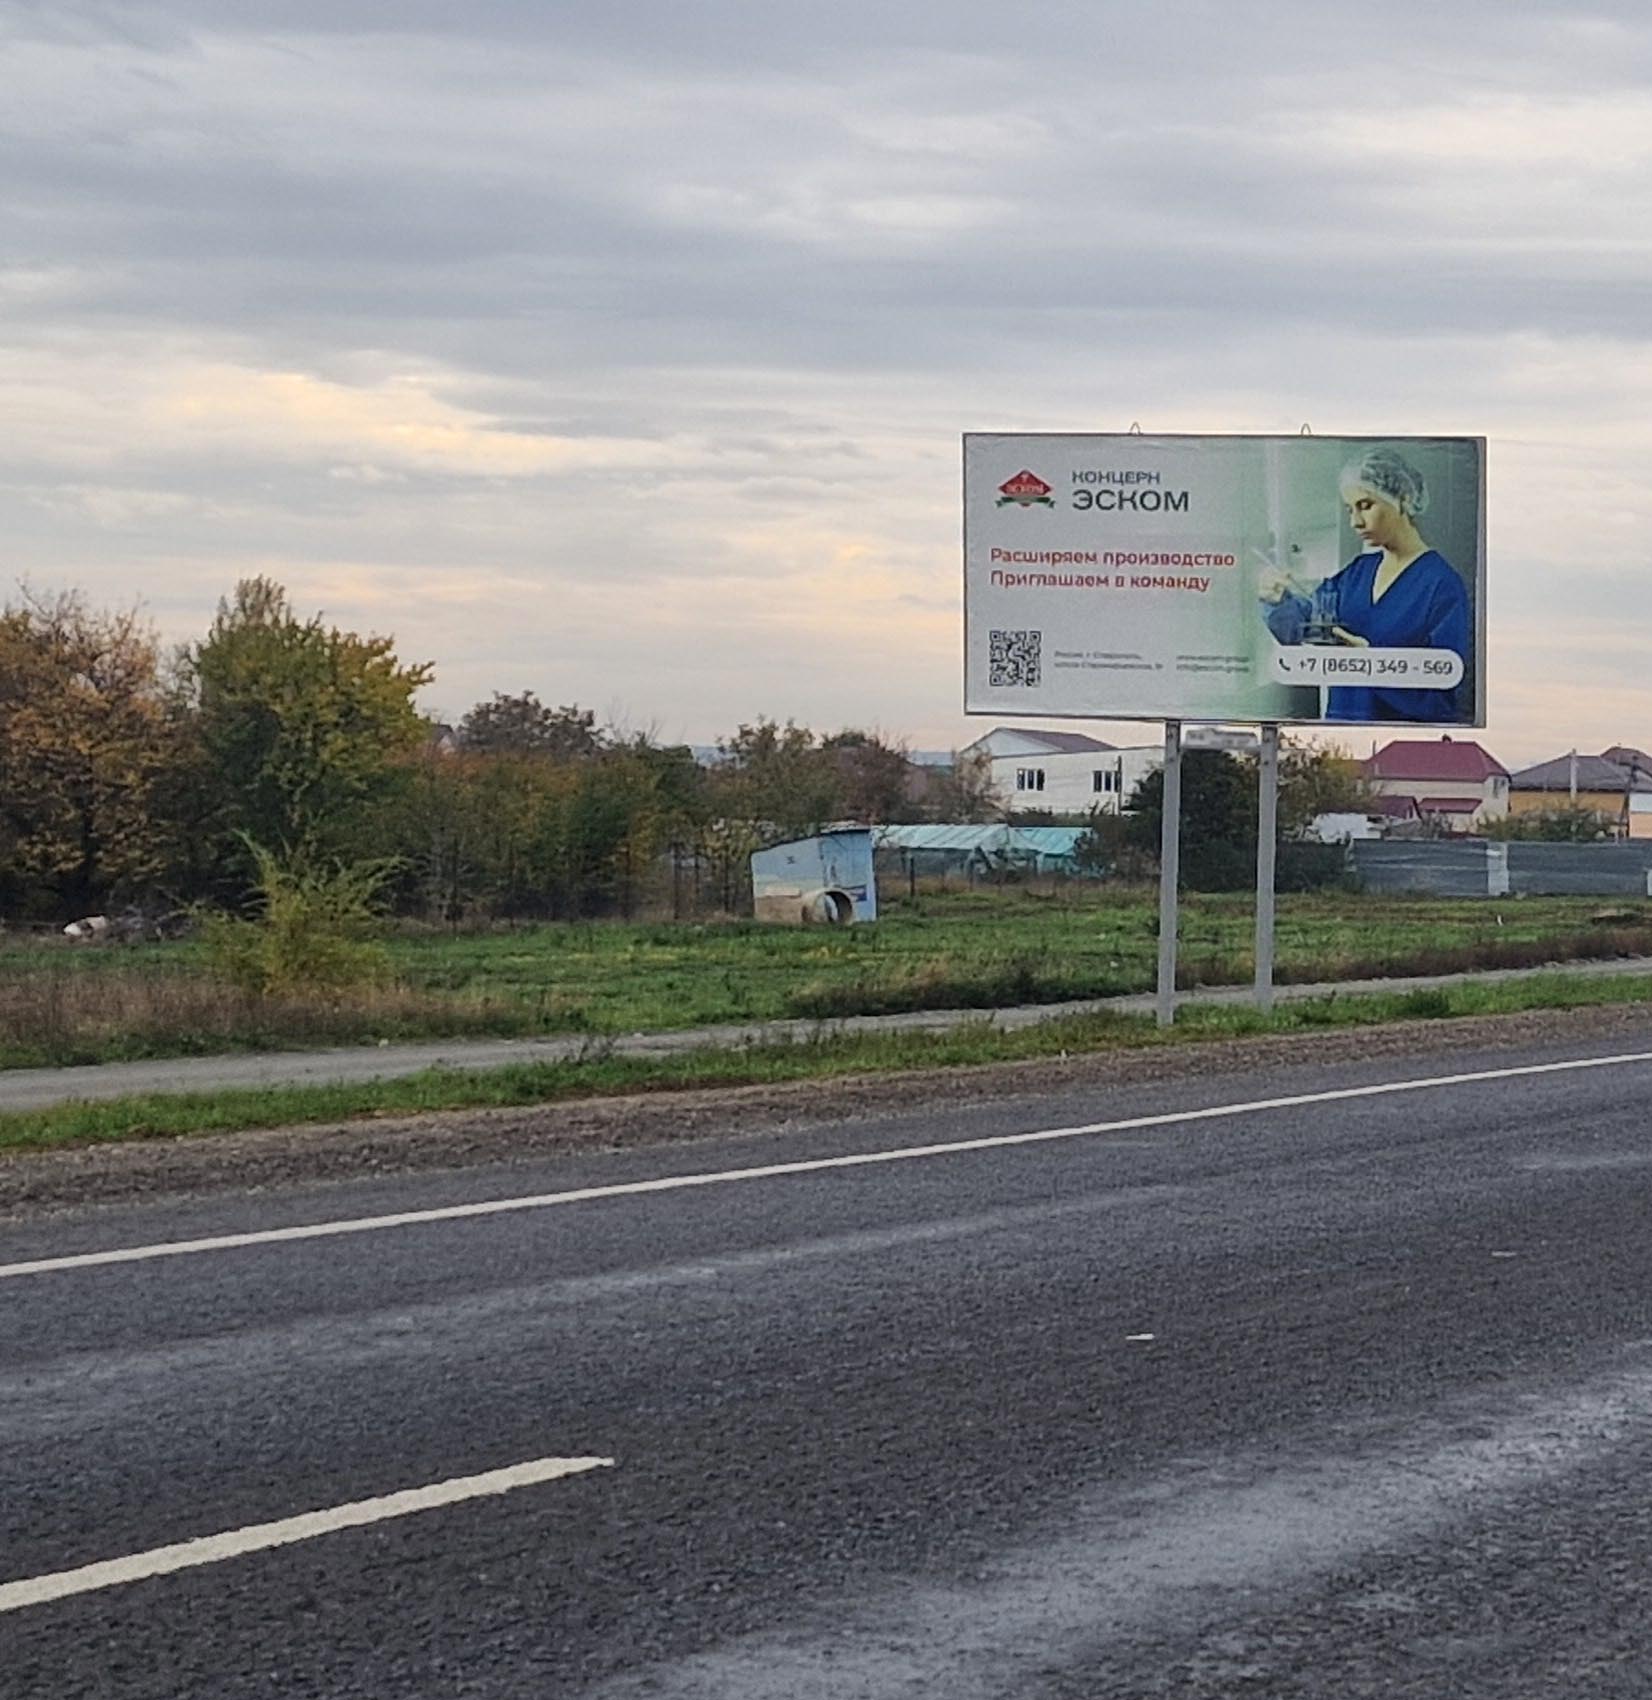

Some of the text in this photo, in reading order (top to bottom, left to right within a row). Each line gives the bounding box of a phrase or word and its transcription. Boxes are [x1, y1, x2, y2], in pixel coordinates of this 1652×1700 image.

[1072, 471, 1161, 485] КОНЦЕРН
[1072, 489, 1190, 512] ЭСКОМ
[990, 548, 1235, 567] Расширяем производство
[990, 570, 1210, 592] Приглашаем в команду
[1299, 658, 1317, 672] +7
[1322, 658, 1373, 675] (8652)
[1376, 660, 1409, 674] 349
